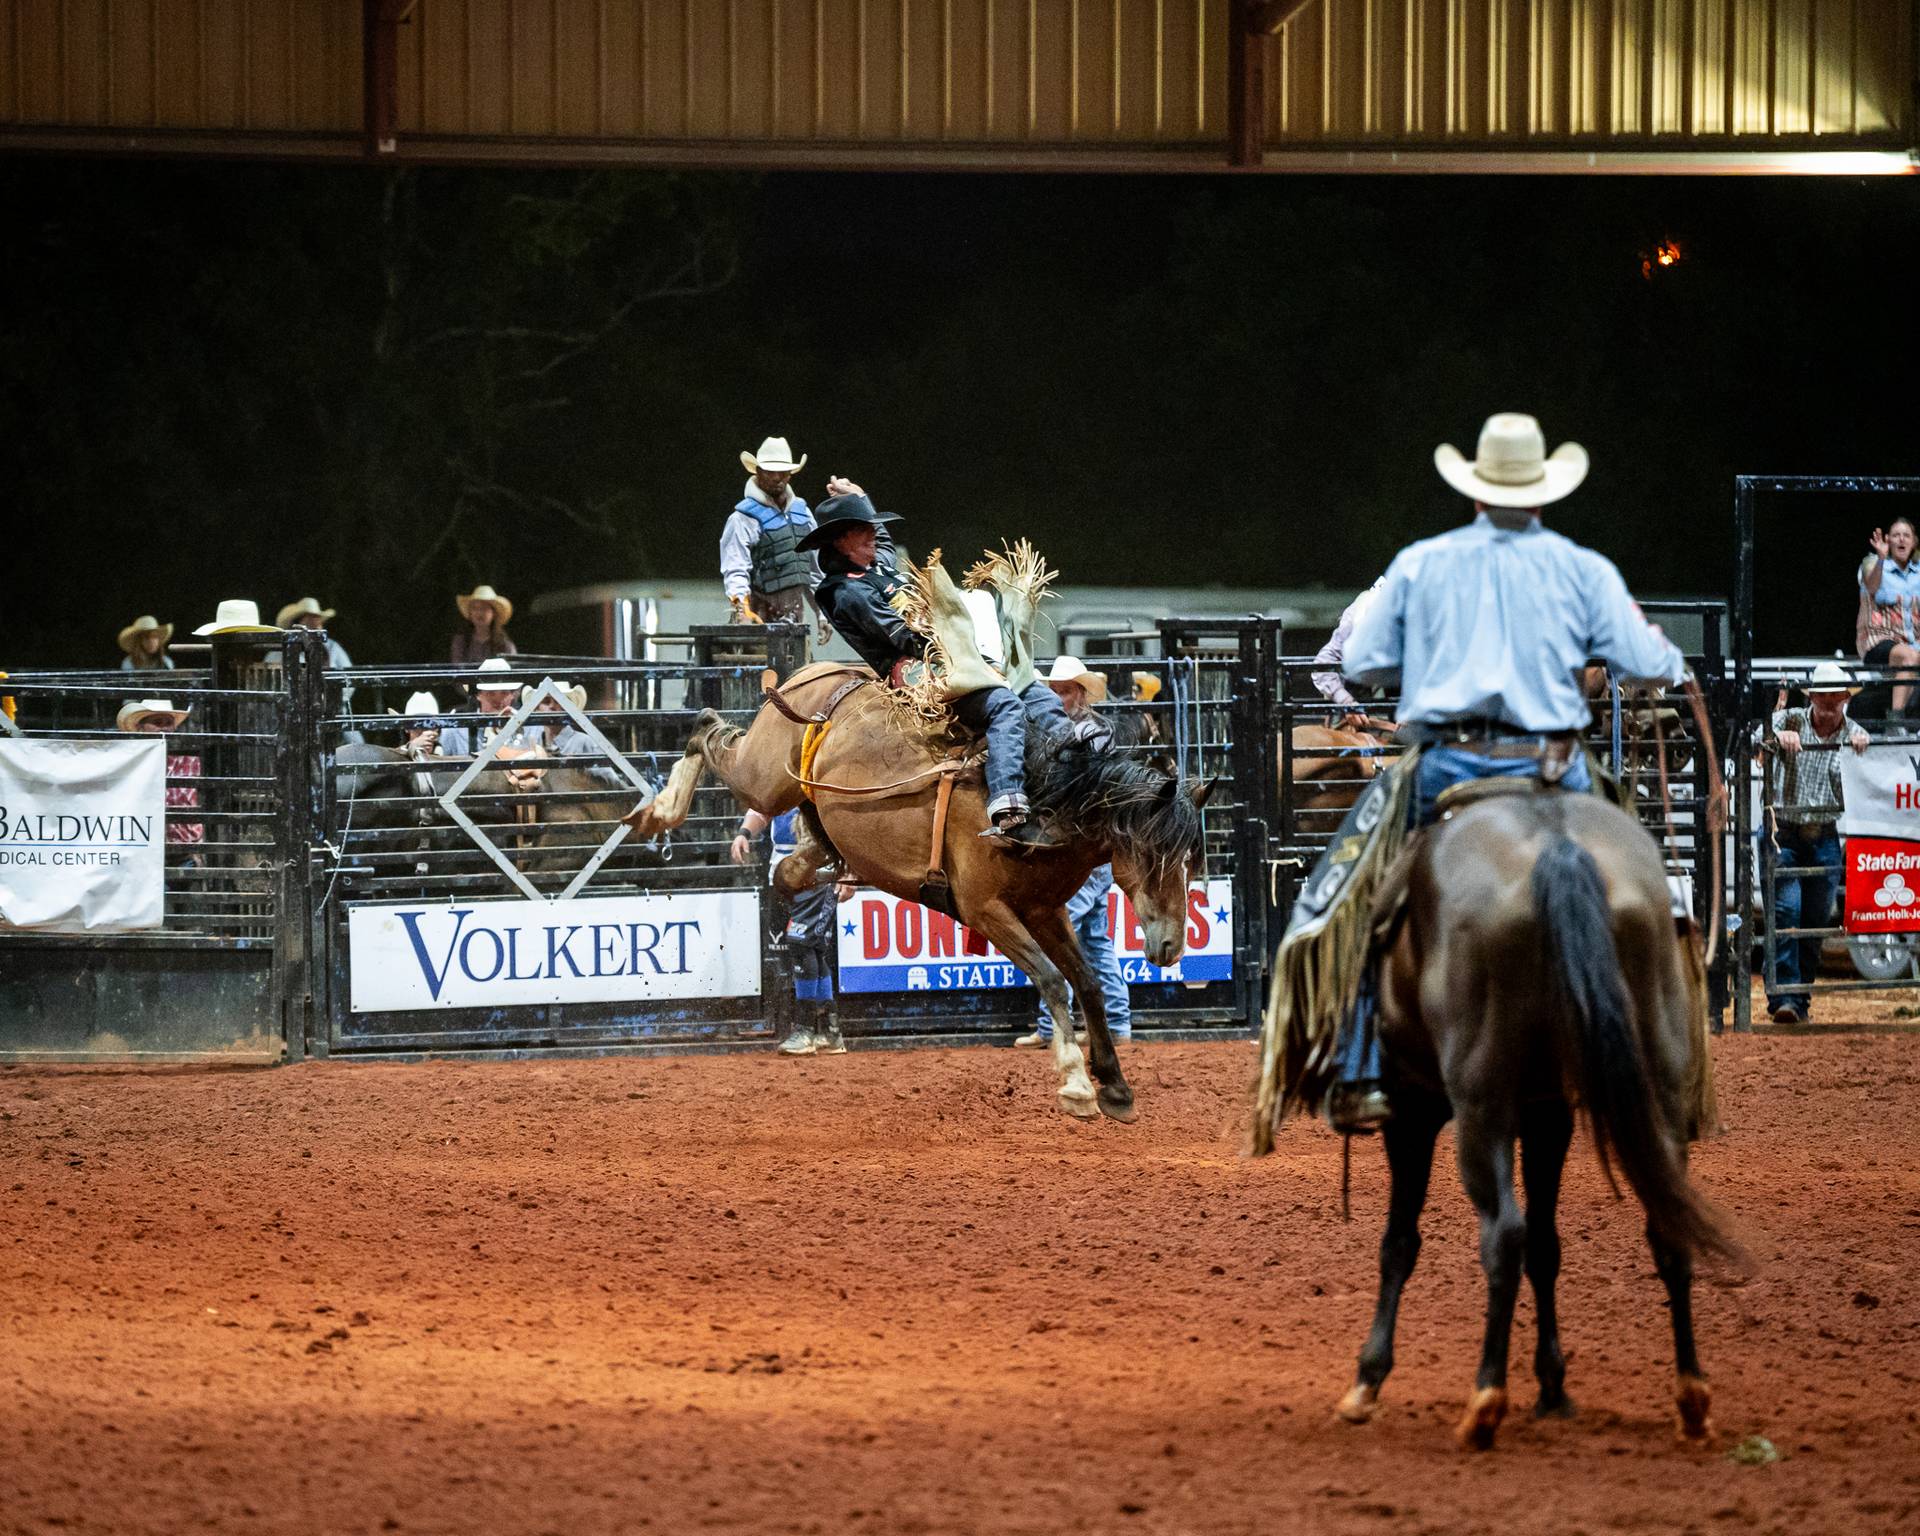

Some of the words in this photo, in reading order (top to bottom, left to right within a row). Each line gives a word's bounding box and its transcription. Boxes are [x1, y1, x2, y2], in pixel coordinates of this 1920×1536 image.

[52, 852, 121, 866] CENTER
[394, 910, 702, 1002] VOLKERT
[938, 964, 1015, 989] STATE
[1122, 960, 1153, 982] 64
